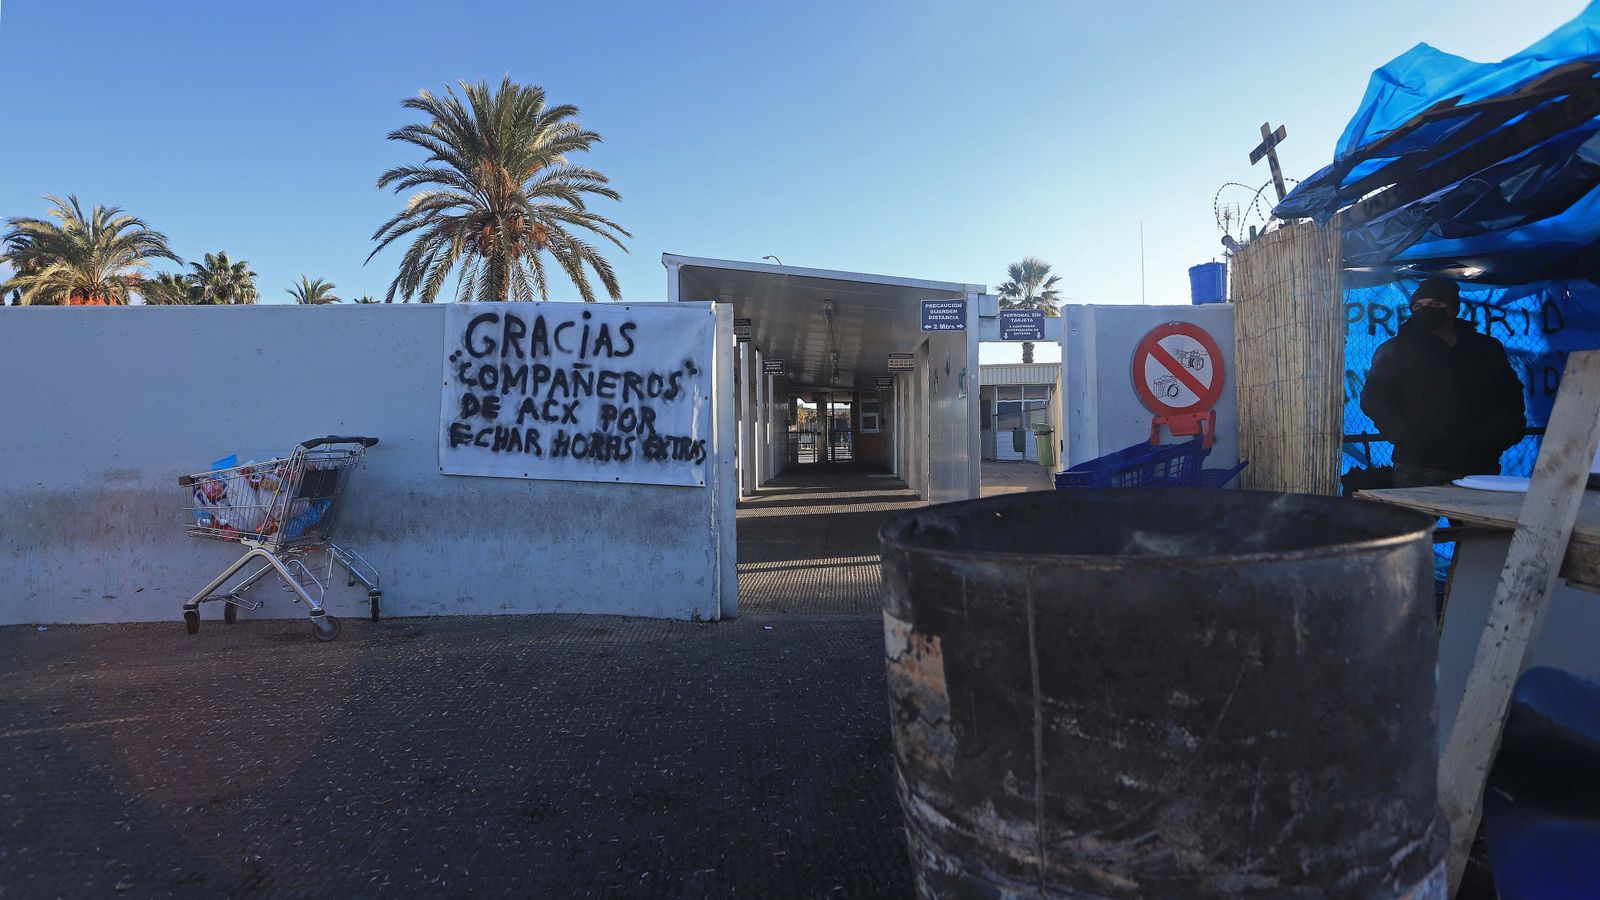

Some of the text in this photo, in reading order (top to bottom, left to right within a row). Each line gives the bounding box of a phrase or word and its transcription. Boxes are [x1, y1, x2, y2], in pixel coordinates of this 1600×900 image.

[460, 392, 657, 435] DE ACX POR
[449, 422, 543, 457] ECHAR
[552, 429, 637, 461] HORAS
